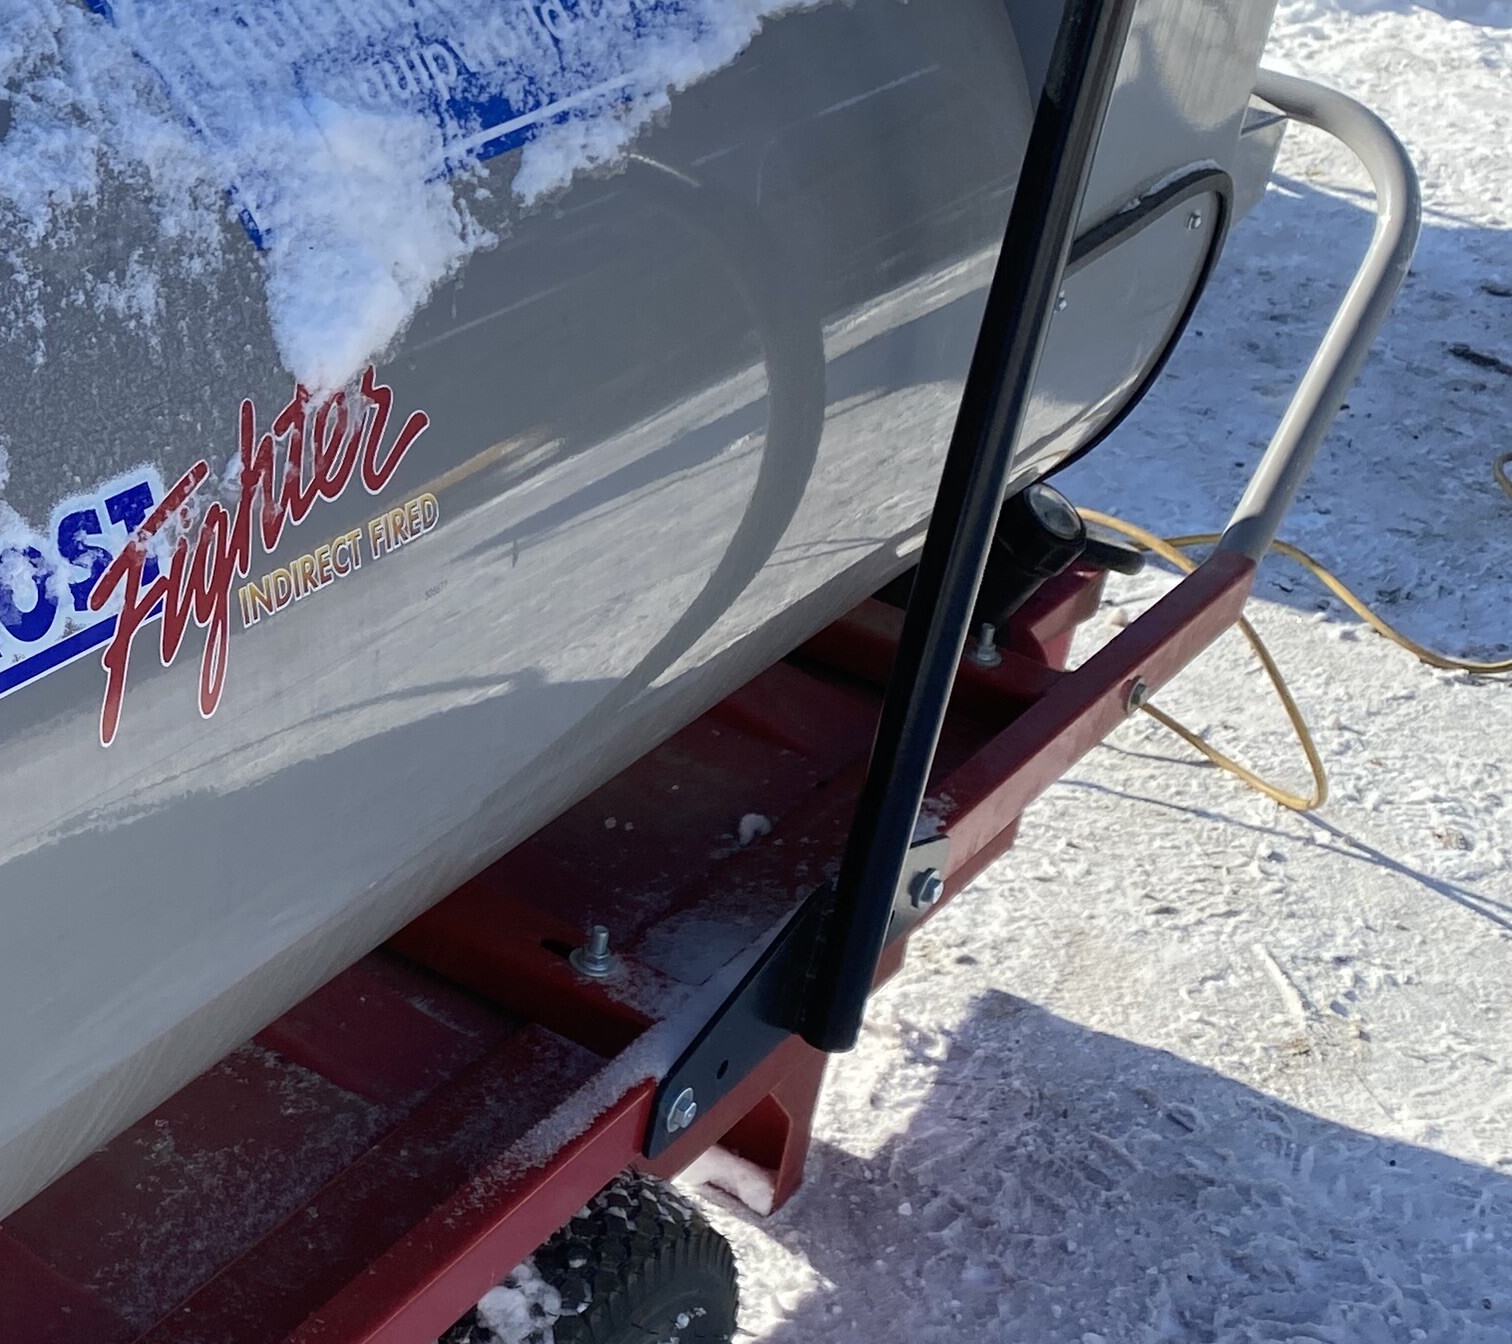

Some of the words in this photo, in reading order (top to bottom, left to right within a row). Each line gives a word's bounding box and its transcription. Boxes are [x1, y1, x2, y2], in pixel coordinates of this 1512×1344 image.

[86, 364, 430, 748] Fighter
[238, 534, 364, 629] INDIRECT
[368, 493, 441, 560] FIRED
